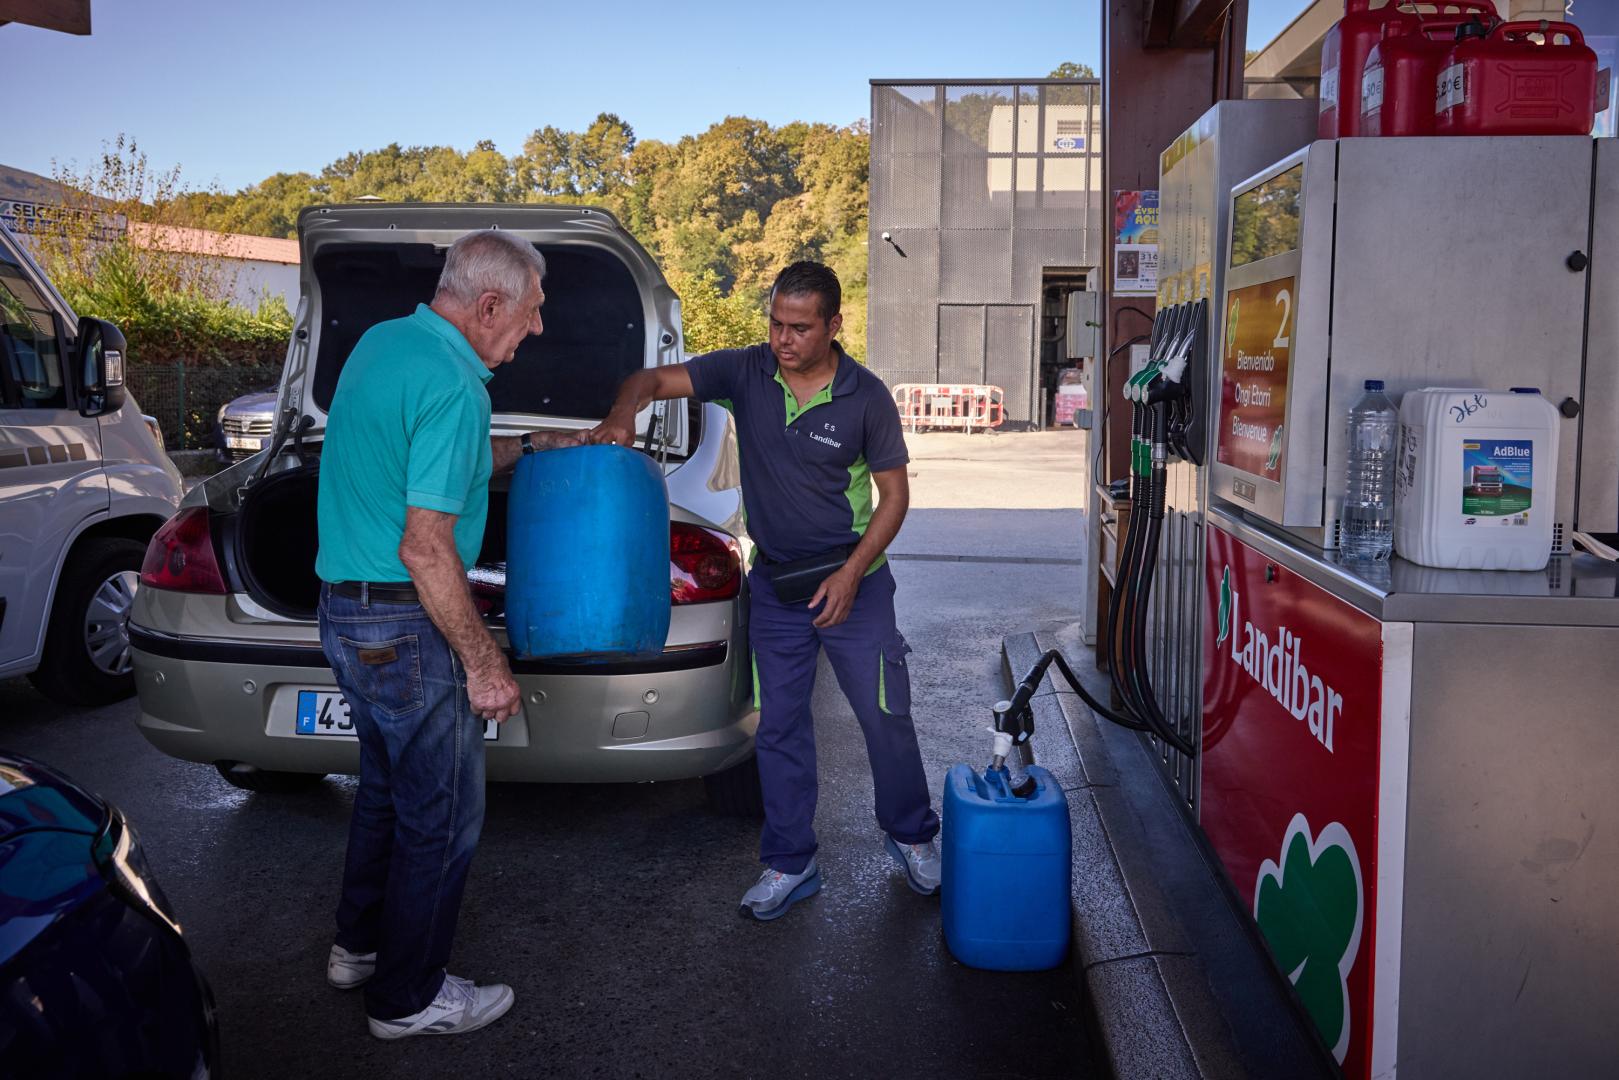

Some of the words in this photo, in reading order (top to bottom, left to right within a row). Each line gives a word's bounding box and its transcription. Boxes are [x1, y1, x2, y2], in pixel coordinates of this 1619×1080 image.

[1273, 288, 1291, 348] 2
[1236, 349, 1275, 372] Bienvenido
[1234, 382, 1250, 408] Ongi
[1251, 385, 1272, 408] Etorri
[809, 431, 842, 449] Landibar
[1232, 415, 1268, 442] Bienvenue
[1493, 446, 1530, 457] AdBlue
[1231, 590, 1344, 754] Landibar
[303, 716, 311, 727] F
[318, 697, 354, 730] 43
